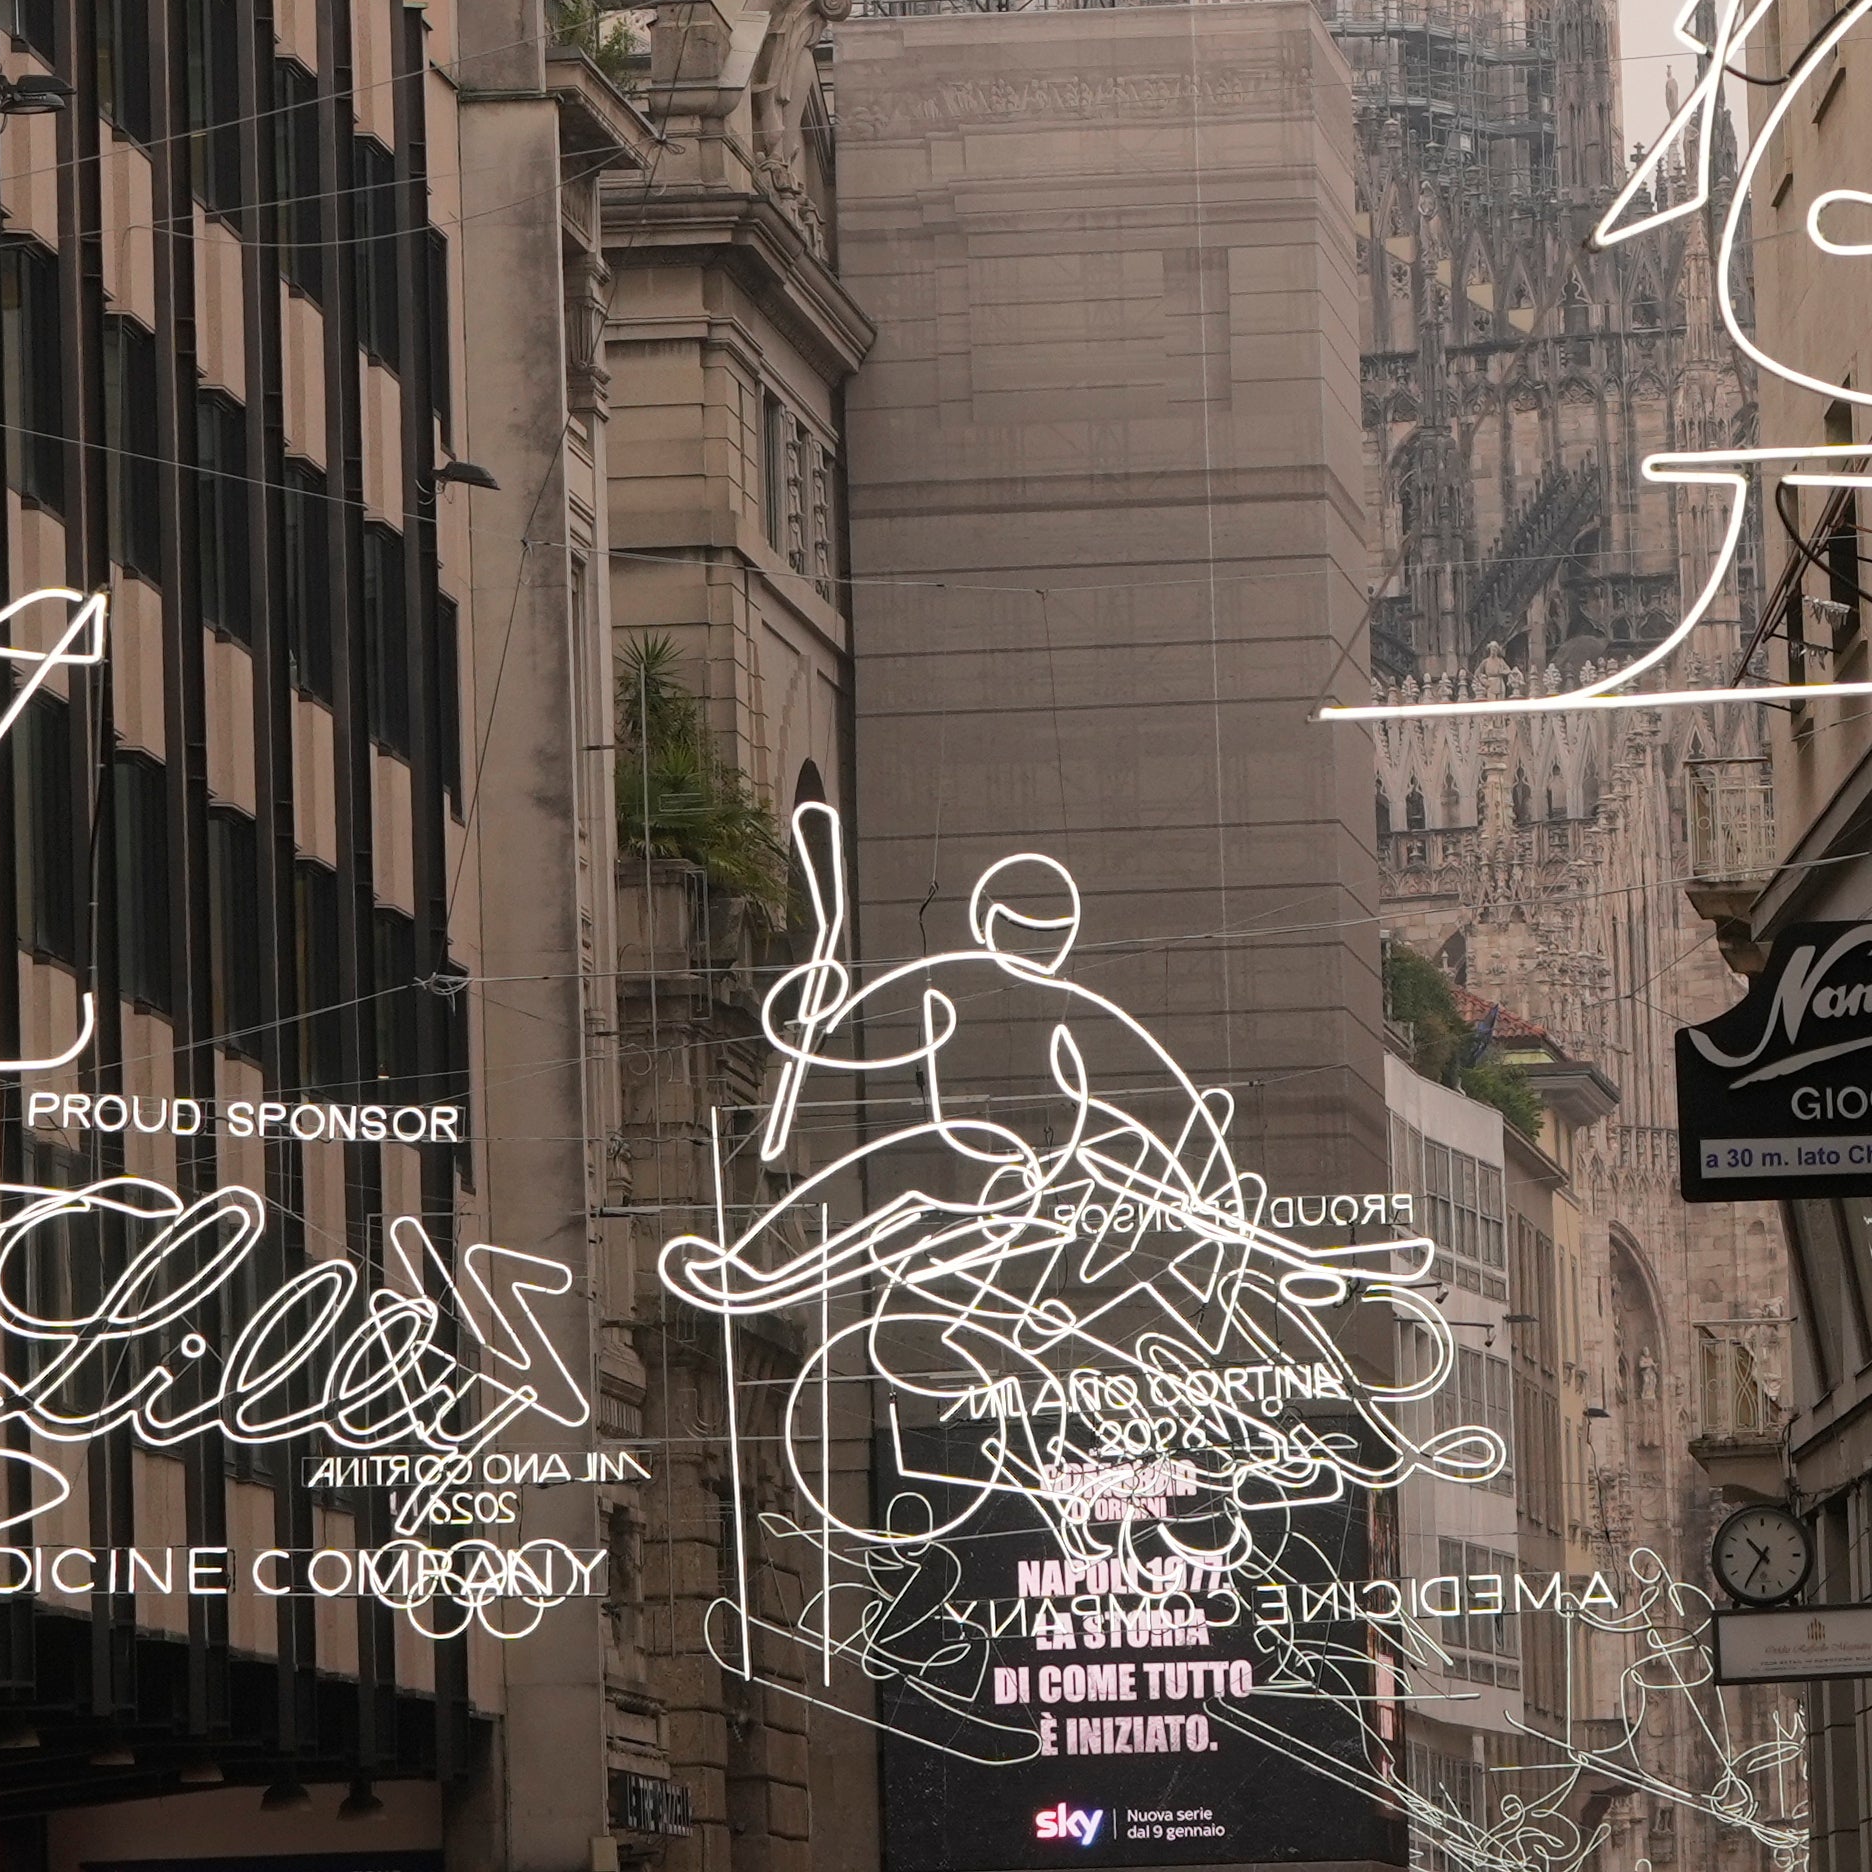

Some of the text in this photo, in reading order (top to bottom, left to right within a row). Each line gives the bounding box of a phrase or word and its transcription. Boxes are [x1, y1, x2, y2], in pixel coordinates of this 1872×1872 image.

[28, 1091, 460, 1143] PROUD SPONSOR
[1705, 1152, 1720, 1168] a
[1727, 1148, 1754, 1168] 30
[1761, 1150, 1789, 1167] m.
[1797, 1146, 1841, 1166] lato
[939, 1374, 1138, 1422] MILANO
[252, 1548, 608, 1597] COMPANY
[1017, 1556, 1232, 1598] NAPOLI 1977.
[1035, 1608, 1211, 1651] LA STORIA
[993, 1659, 1255, 1705] DI COME TUTTO
[1039, 1711, 1220, 1757] È INIZIATO.
[1035, 1802, 1104, 1846] sky
[1126, 1807, 1214, 1823] Nuova serie
[1126, 1823, 1226, 1841] dal 9 gennaio
